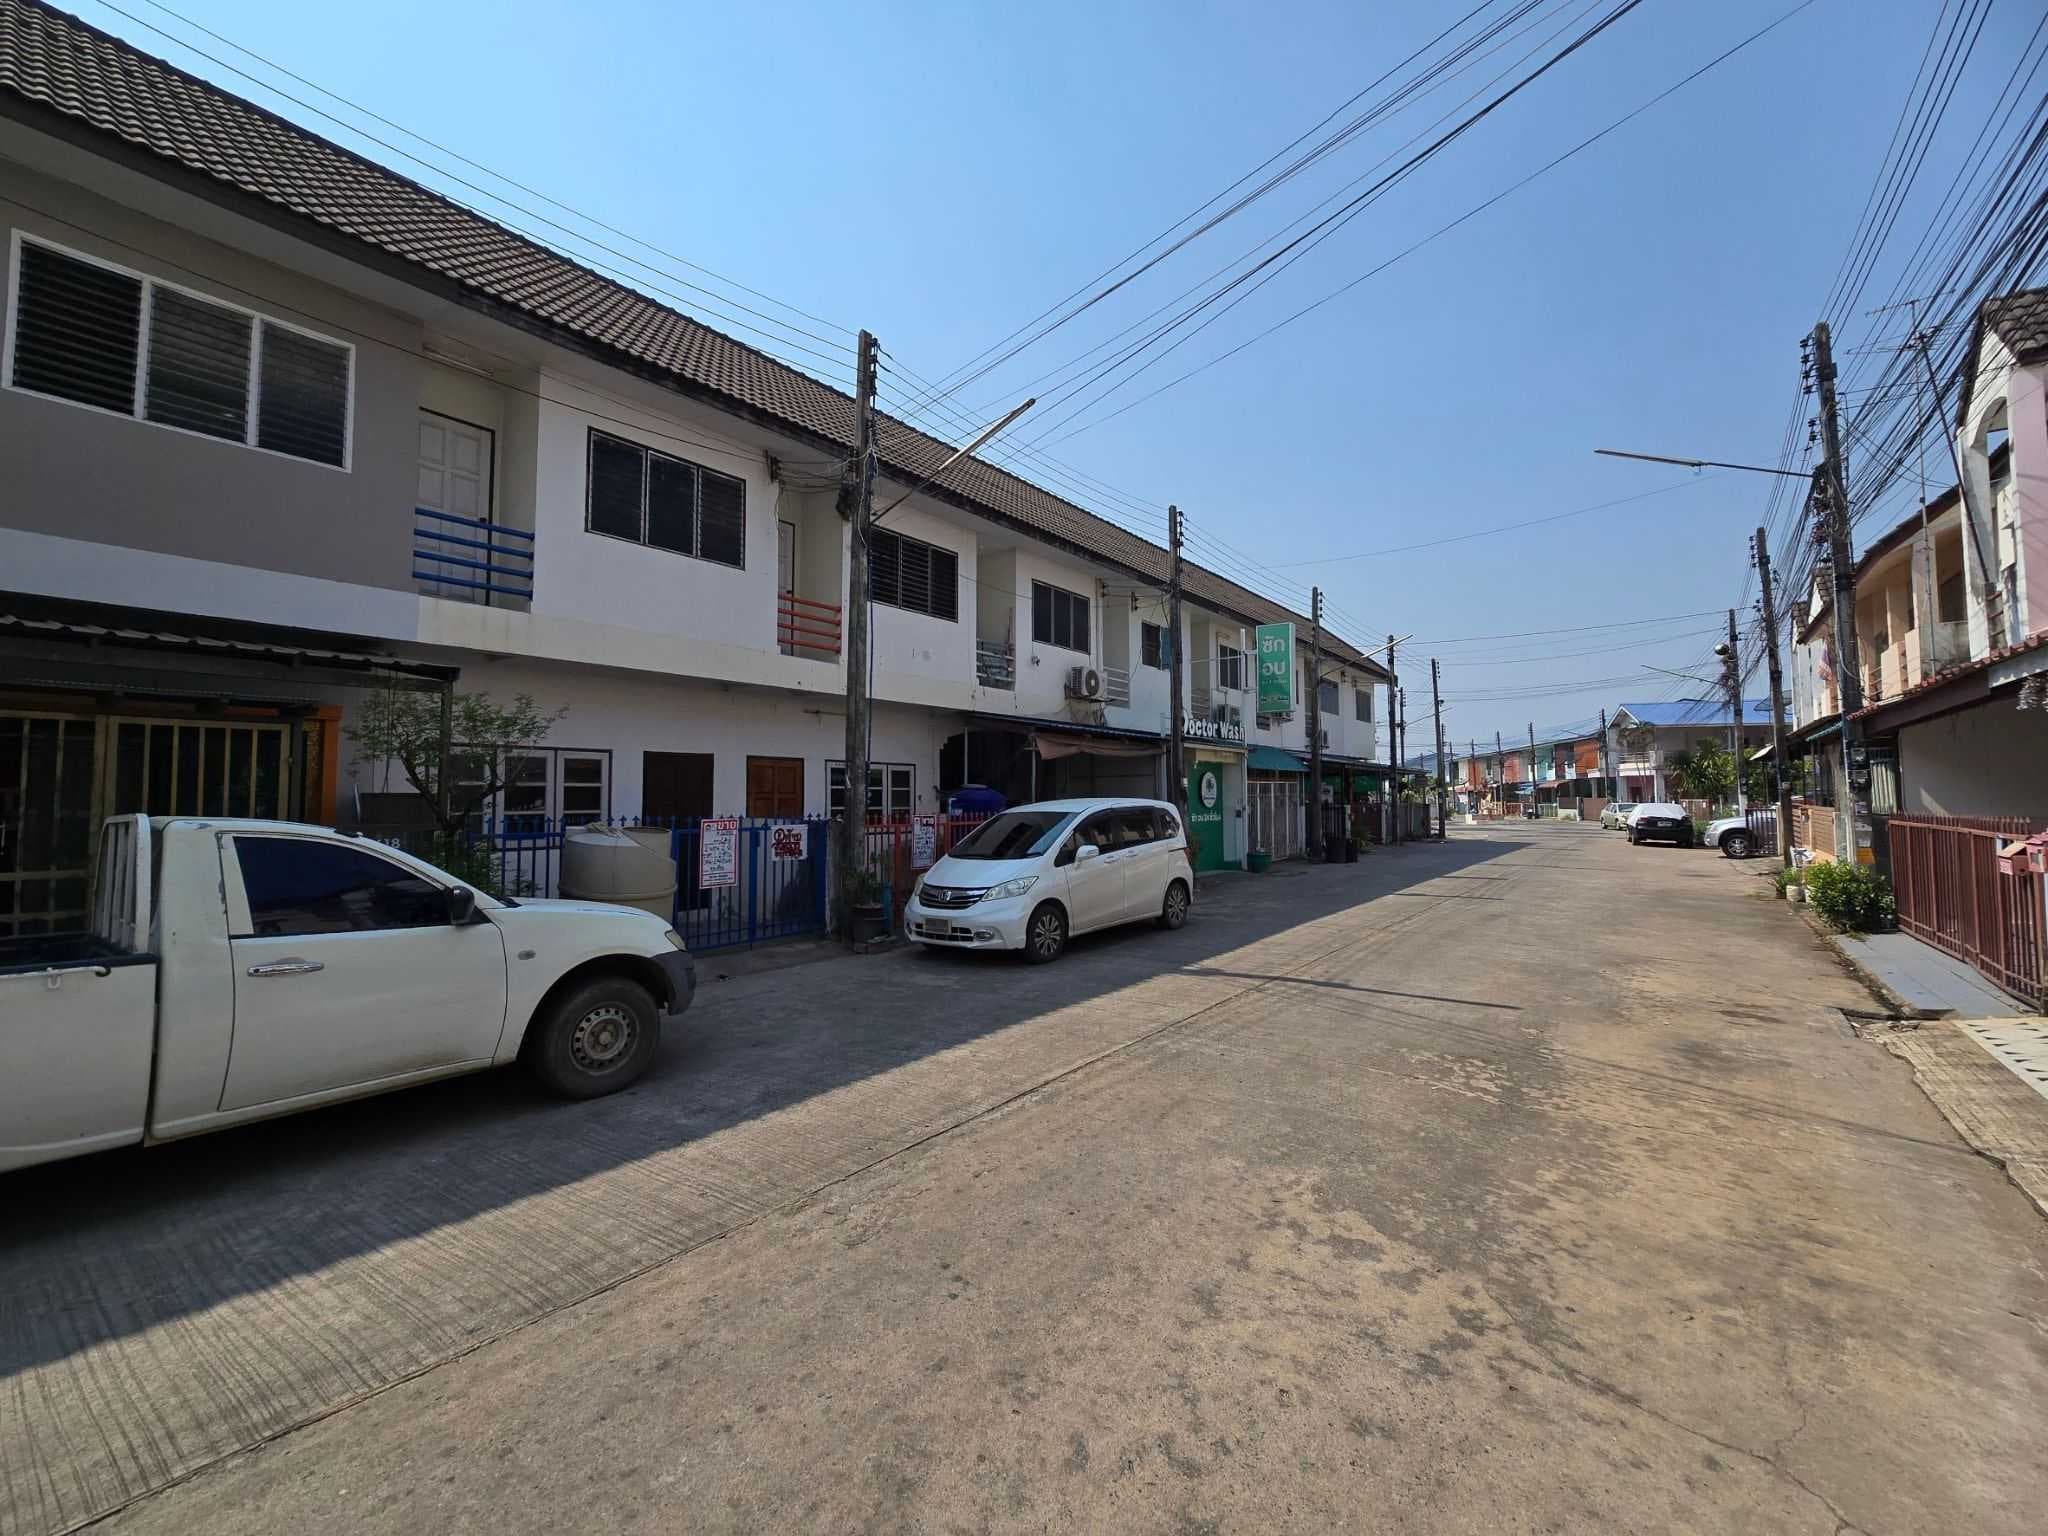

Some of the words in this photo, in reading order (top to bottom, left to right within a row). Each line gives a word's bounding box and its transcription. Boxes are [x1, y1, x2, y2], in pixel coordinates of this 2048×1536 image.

[1263, 635, 1285, 653] ซัก
[1262, 661, 1286, 676] อบ
[1219, 716, 1245, 740] Wash
